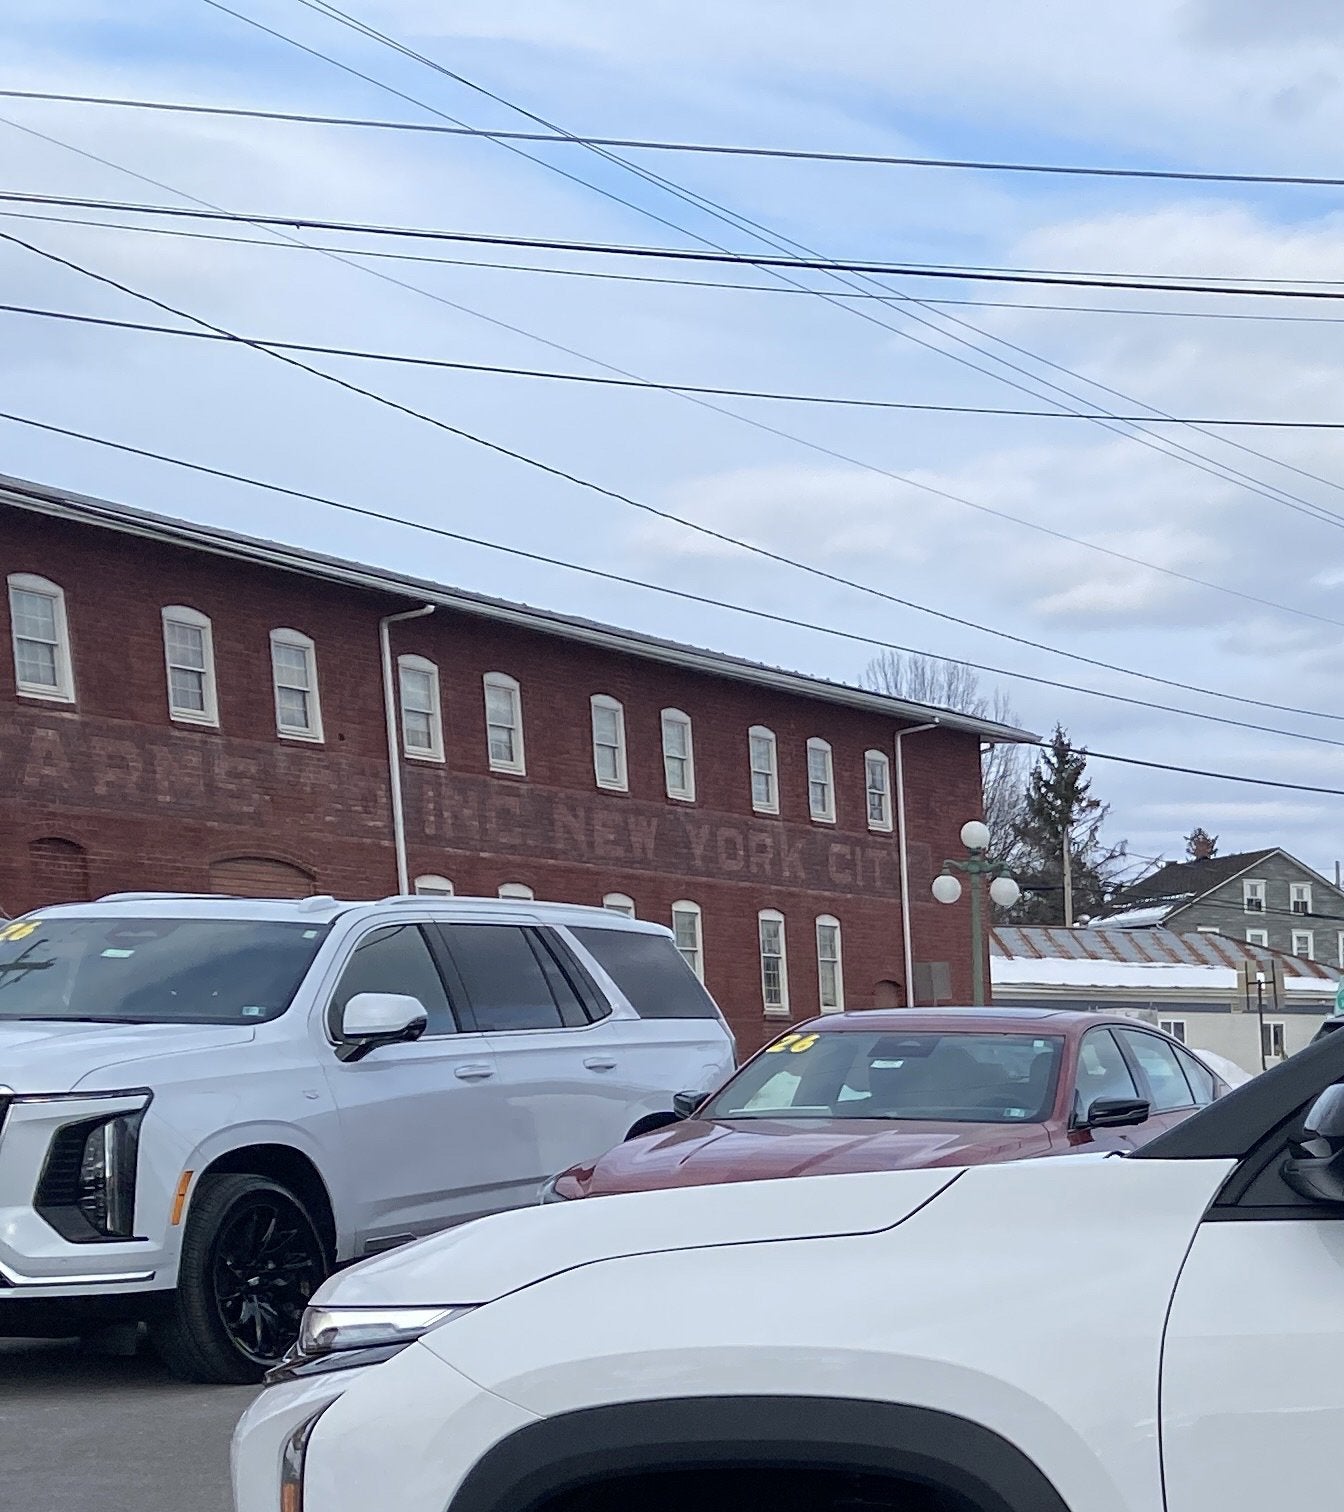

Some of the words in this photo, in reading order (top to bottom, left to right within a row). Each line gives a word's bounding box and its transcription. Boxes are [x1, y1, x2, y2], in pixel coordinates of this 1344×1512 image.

[553, 802, 658, 862] NEW
[687, 822, 806, 881] YORK
[766, 1033, 821, 1053] 26
